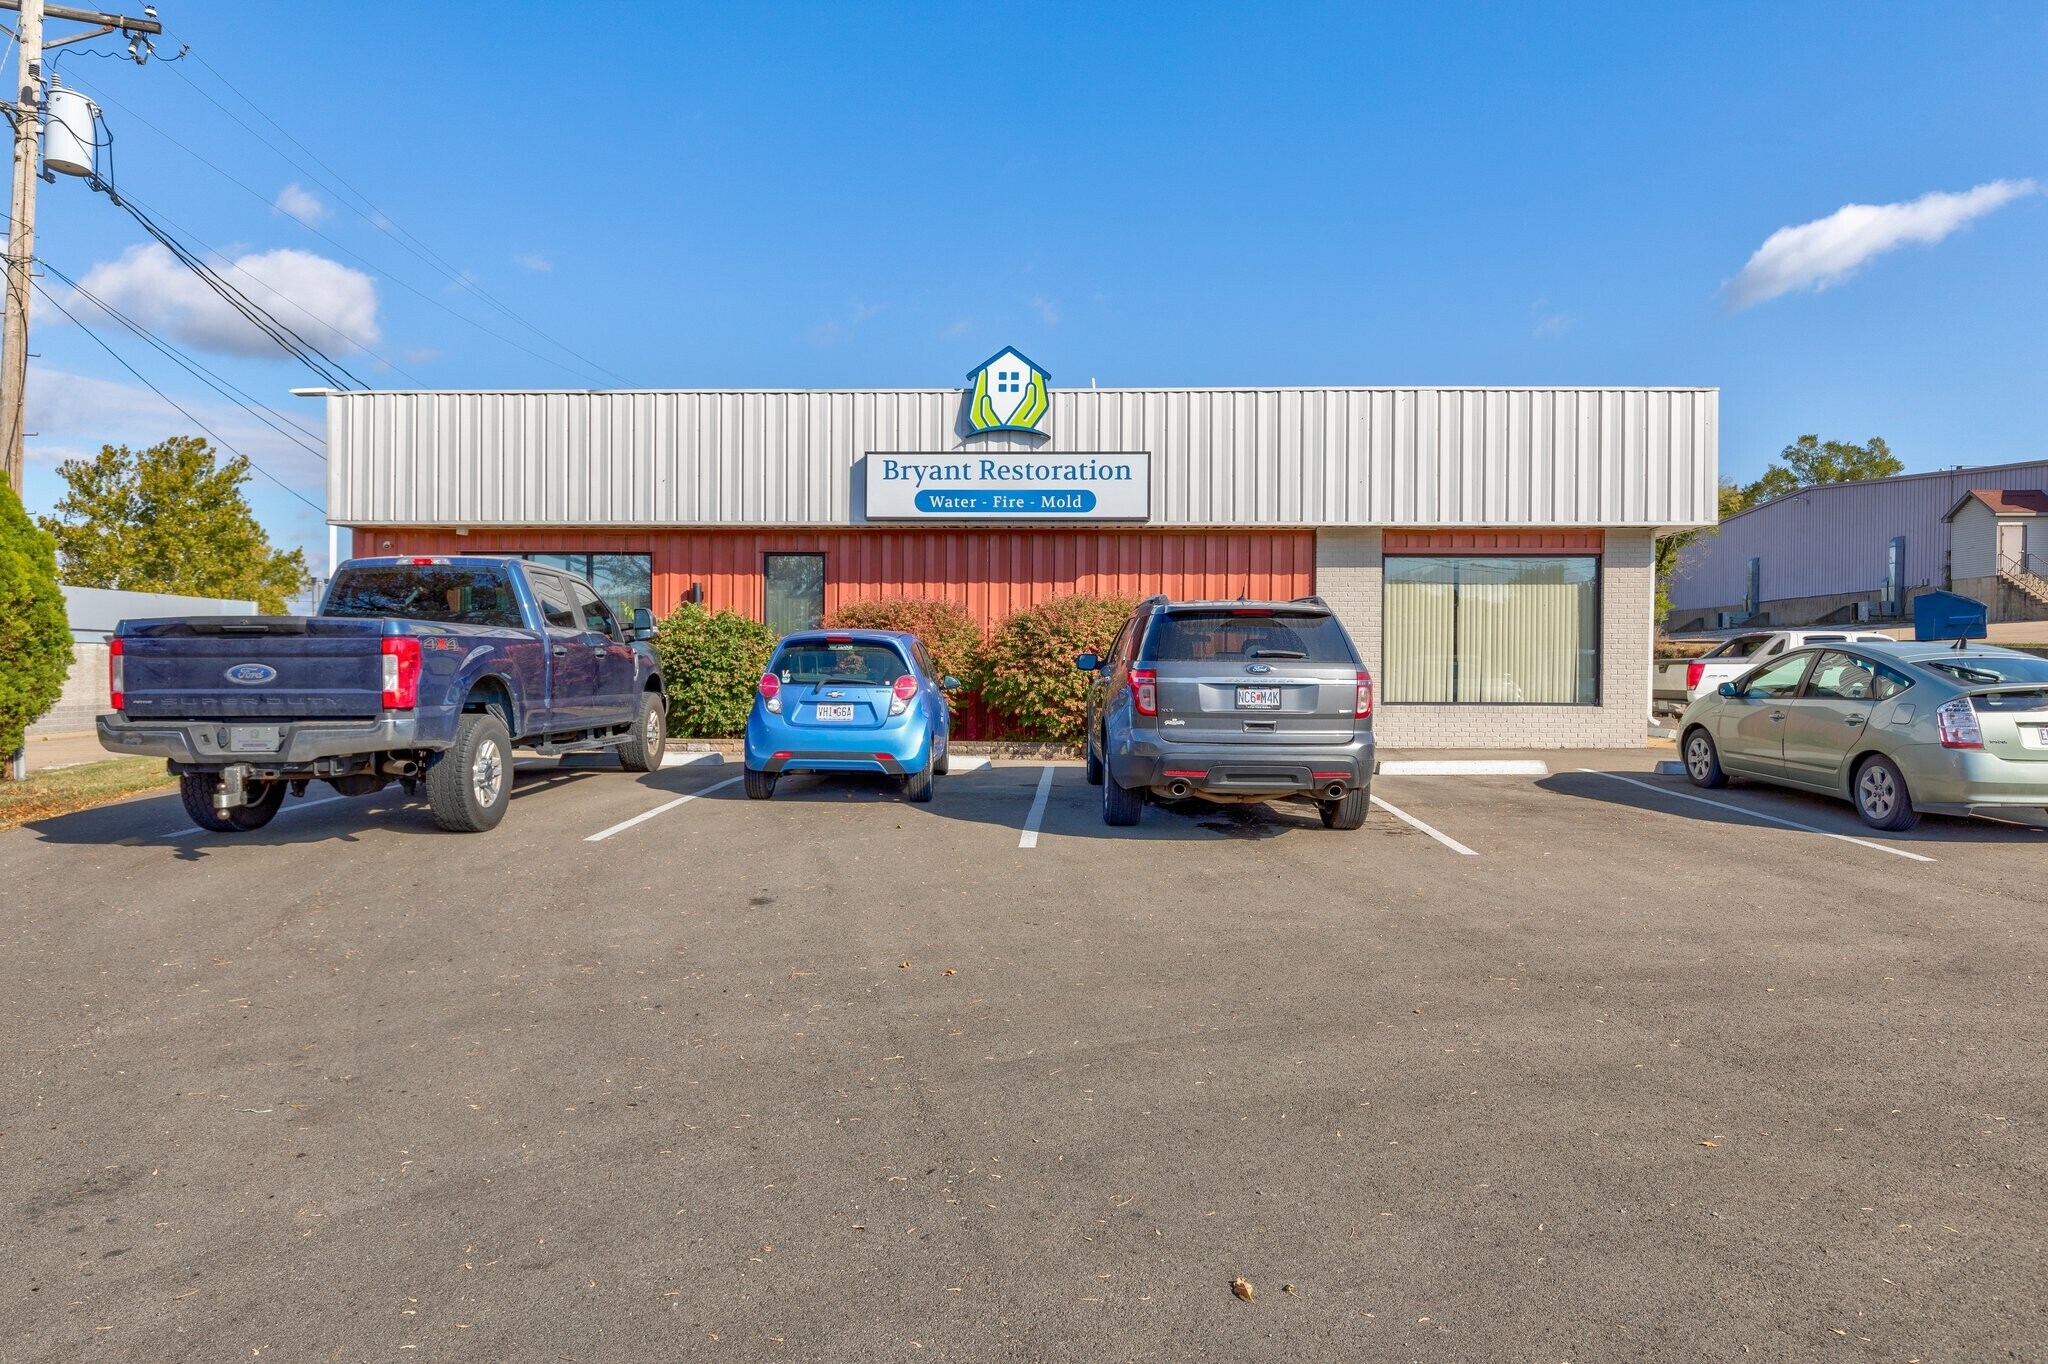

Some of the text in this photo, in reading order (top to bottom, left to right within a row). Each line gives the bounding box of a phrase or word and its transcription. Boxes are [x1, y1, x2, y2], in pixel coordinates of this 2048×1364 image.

[883, 459, 1132, 488] Bryant Restoration
[929, 495, 977, 508] Water
[992, 495, 1025, 508] Fire
[1040, 494, 1083, 508] Mold
[237, 667, 265, 679] Ford
